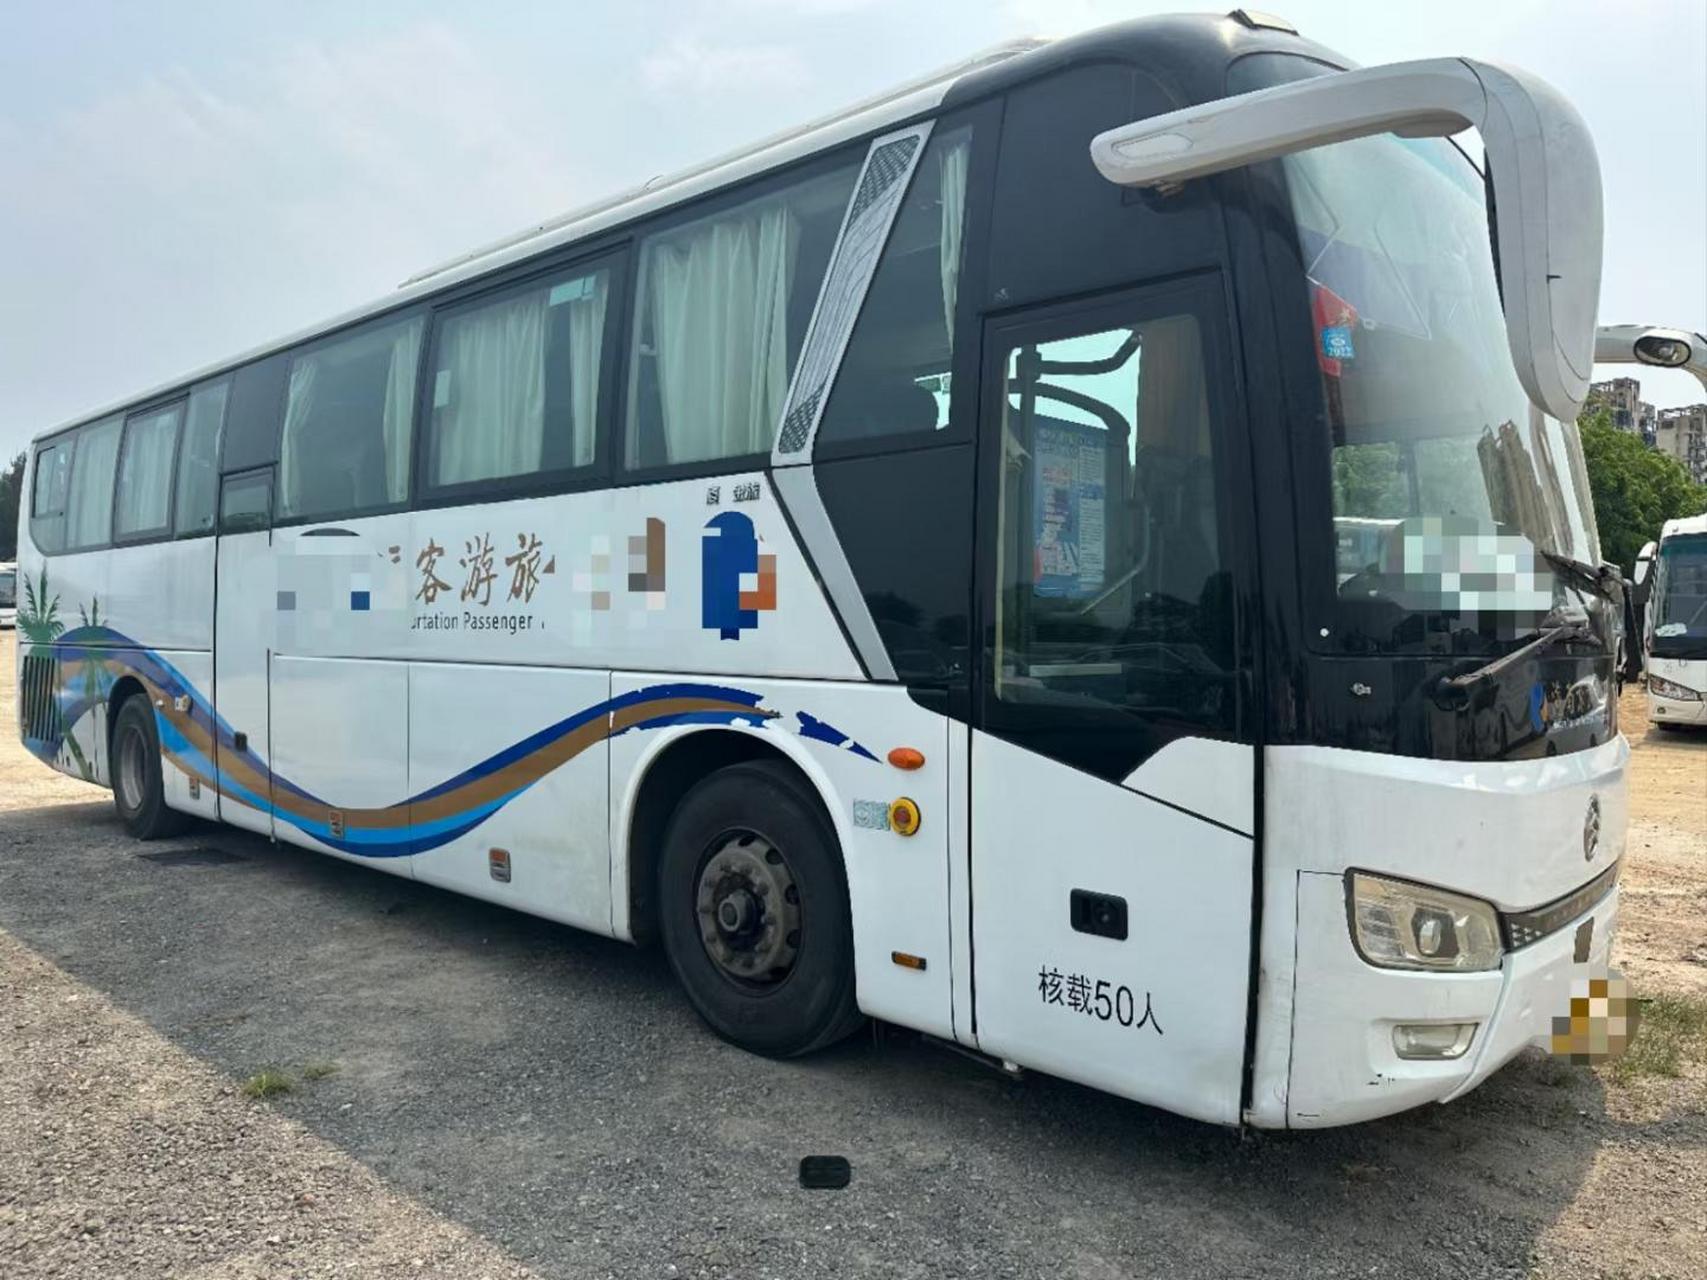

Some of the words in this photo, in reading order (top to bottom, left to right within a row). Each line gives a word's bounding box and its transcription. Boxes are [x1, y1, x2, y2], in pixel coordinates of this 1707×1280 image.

[411, 611, 459, 630] rtation
[463, 611, 533, 636] Passenger
[1038, 964, 1164, 1035] 核载50人
